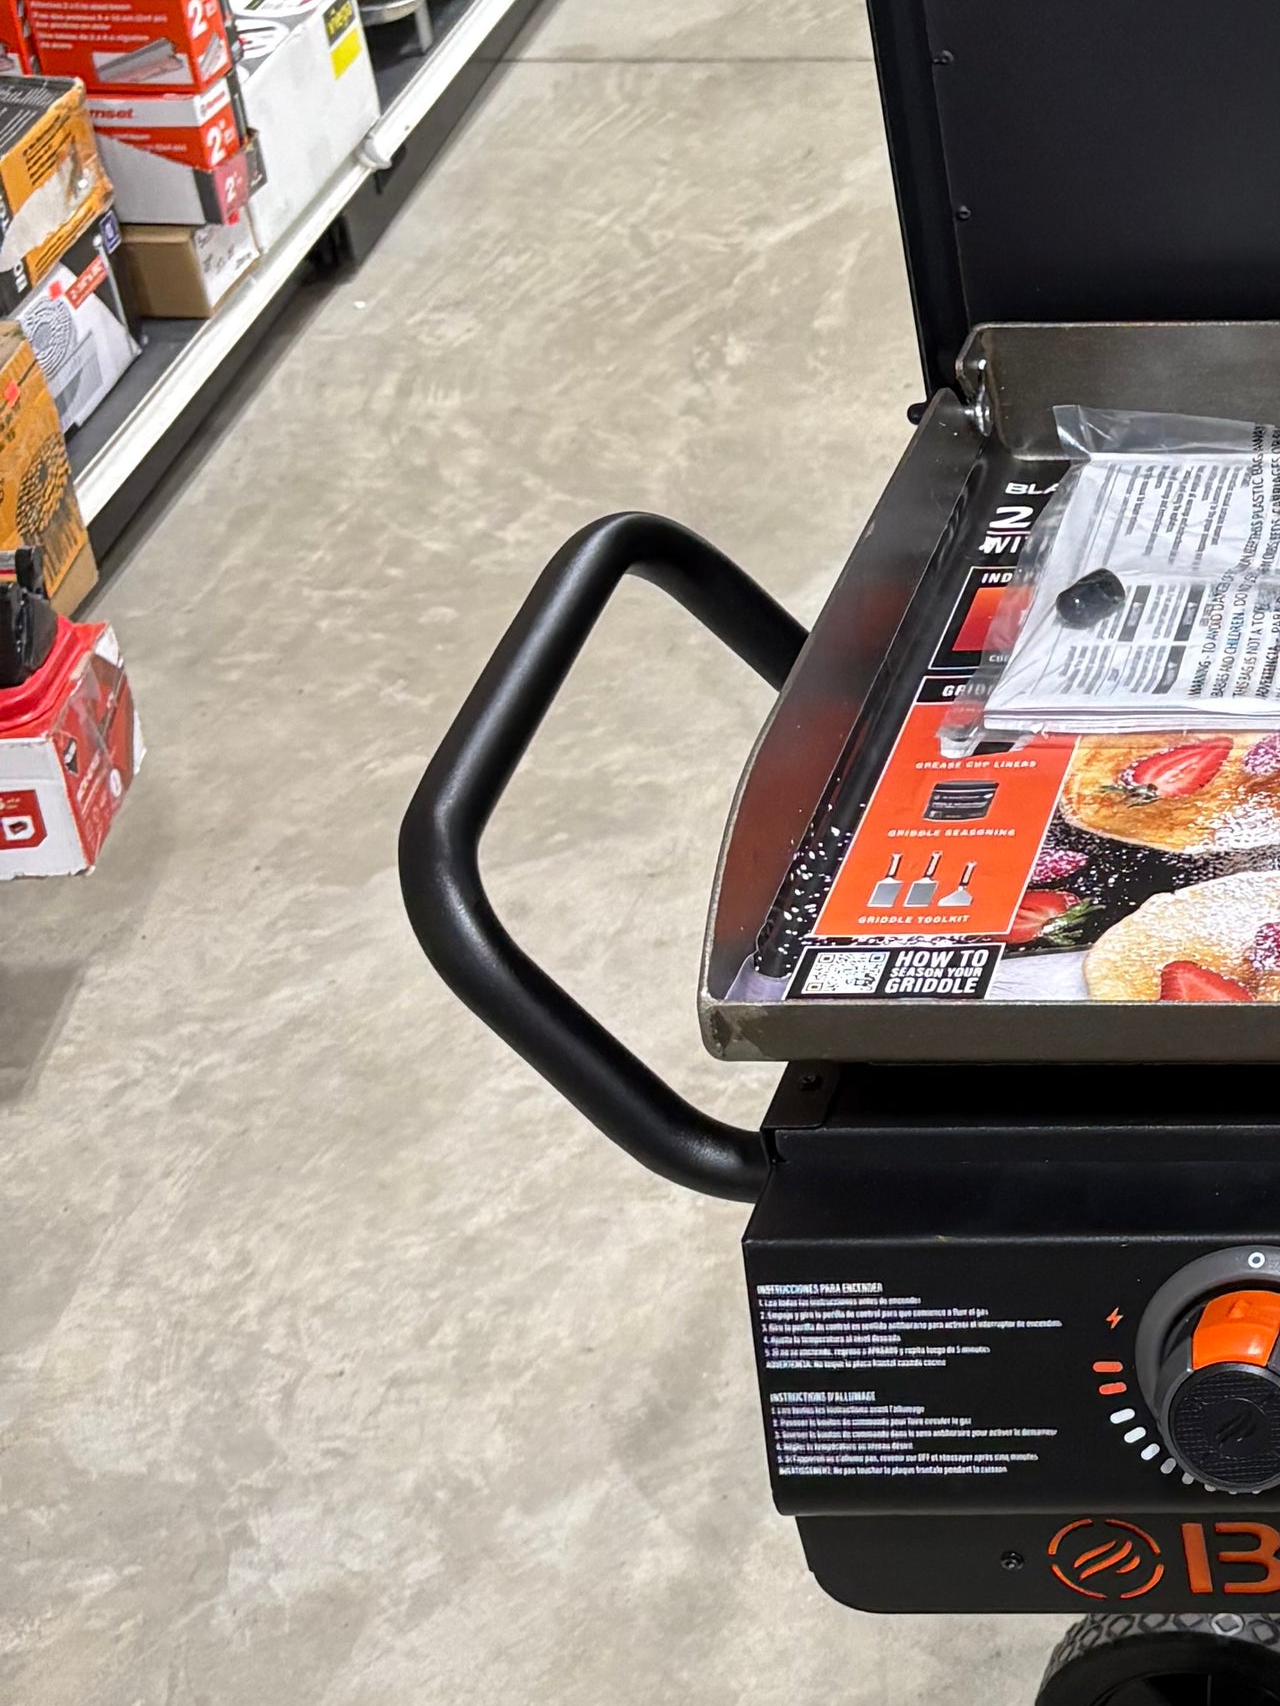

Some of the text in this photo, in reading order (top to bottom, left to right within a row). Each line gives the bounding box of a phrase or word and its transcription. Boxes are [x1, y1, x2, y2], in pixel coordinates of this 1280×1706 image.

[90, 108, 133, 119] mset
[1251, 454, 1264, 476] BAG
[1251, 478, 1265, 519] PLASTIC
[1207, 614, 1223, 641] AVOID
[1201, 642, 1216, 653] TO
[1245, 637, 1261, 654] NOT
[915, 760, 1037, 770] GREASE CUP LINERS
[887, 828, 1016, 837] GRIDDLE SEASONING
[858, 914, 970, 924] GRIDDLE TOOLKIT
[895, 949, 988, 969] HOW TO
[890, 966, 983, 978] SEASON YOUR
[885, 977, 977, 994] GRIDDLE
[820, 1284, 841, 1293] PARA
[842, 1283, 883, 1293] ENCENDER
